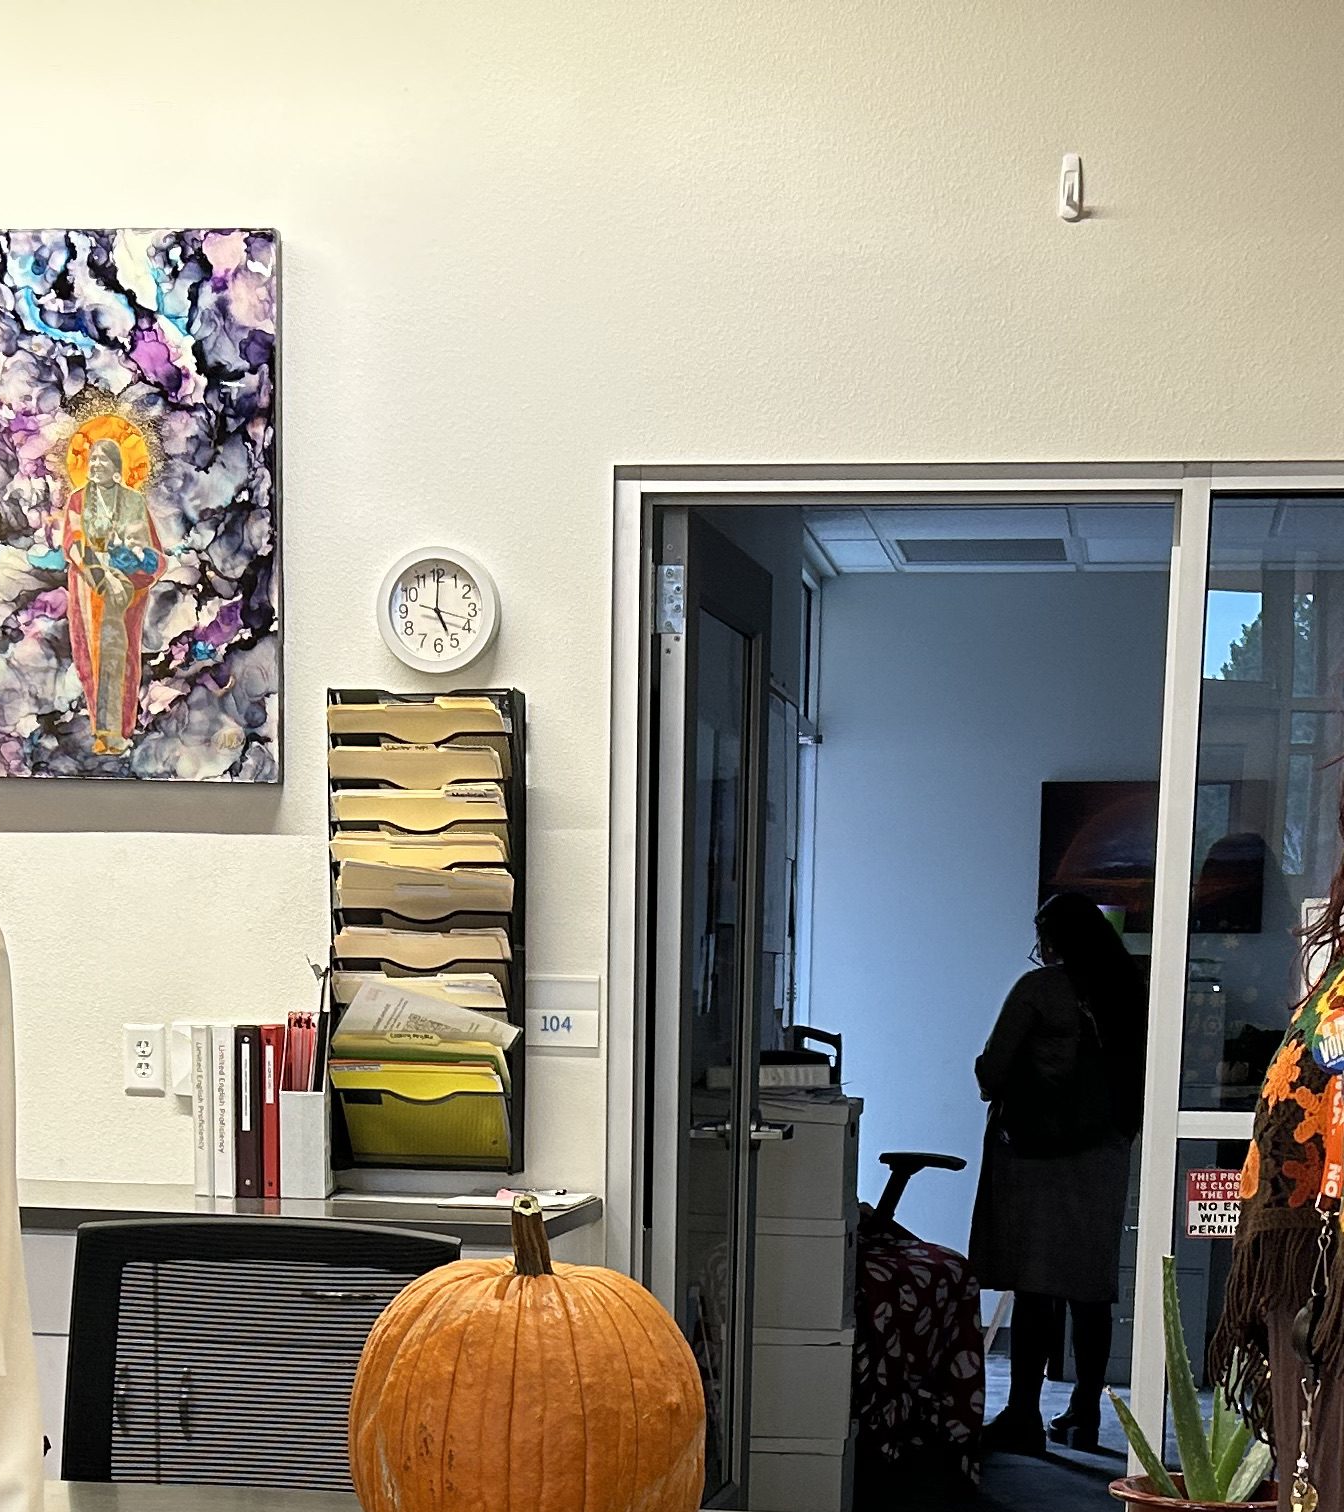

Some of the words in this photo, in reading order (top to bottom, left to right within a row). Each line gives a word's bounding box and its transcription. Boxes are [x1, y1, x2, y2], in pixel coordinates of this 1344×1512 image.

[414, 573, 426, 588] 11
[451, 573, 458, 589] 1
[401, 586, 418, 603] 10
[462, 584, 472, 600] 2
[398, 603, 409, 619] 9
[467, 602, 478, 618] 3
[404, 620, 414, 636] 8
[461, 619, 472, 634] 4
[417, 633, 428, 648] 7
[433, 638, 444, 654] 6
[449, 632, 460, 649] 5
[539, 1015, 573, 1033] 104
[218, 1077, 226, 1106] English
[1190, 1173, 1216, 1181] THIS
[1220, 1173, 1242, 1181] PRO
[1196, 1182, 1207, 1190] IS
[1210, 1182, 1240, 1190] CLOS
[1200, 1190, 1223, 1199] THE
[1226, 1190, 1240, 1199] PU
[1198, 1202, 1218, 1211] NO
[1223, 1202, 1241, 1211] EN
[1200, 1213, 1237, 1223] WITH
[1189, 1225, 1237, 1234] PERMI
